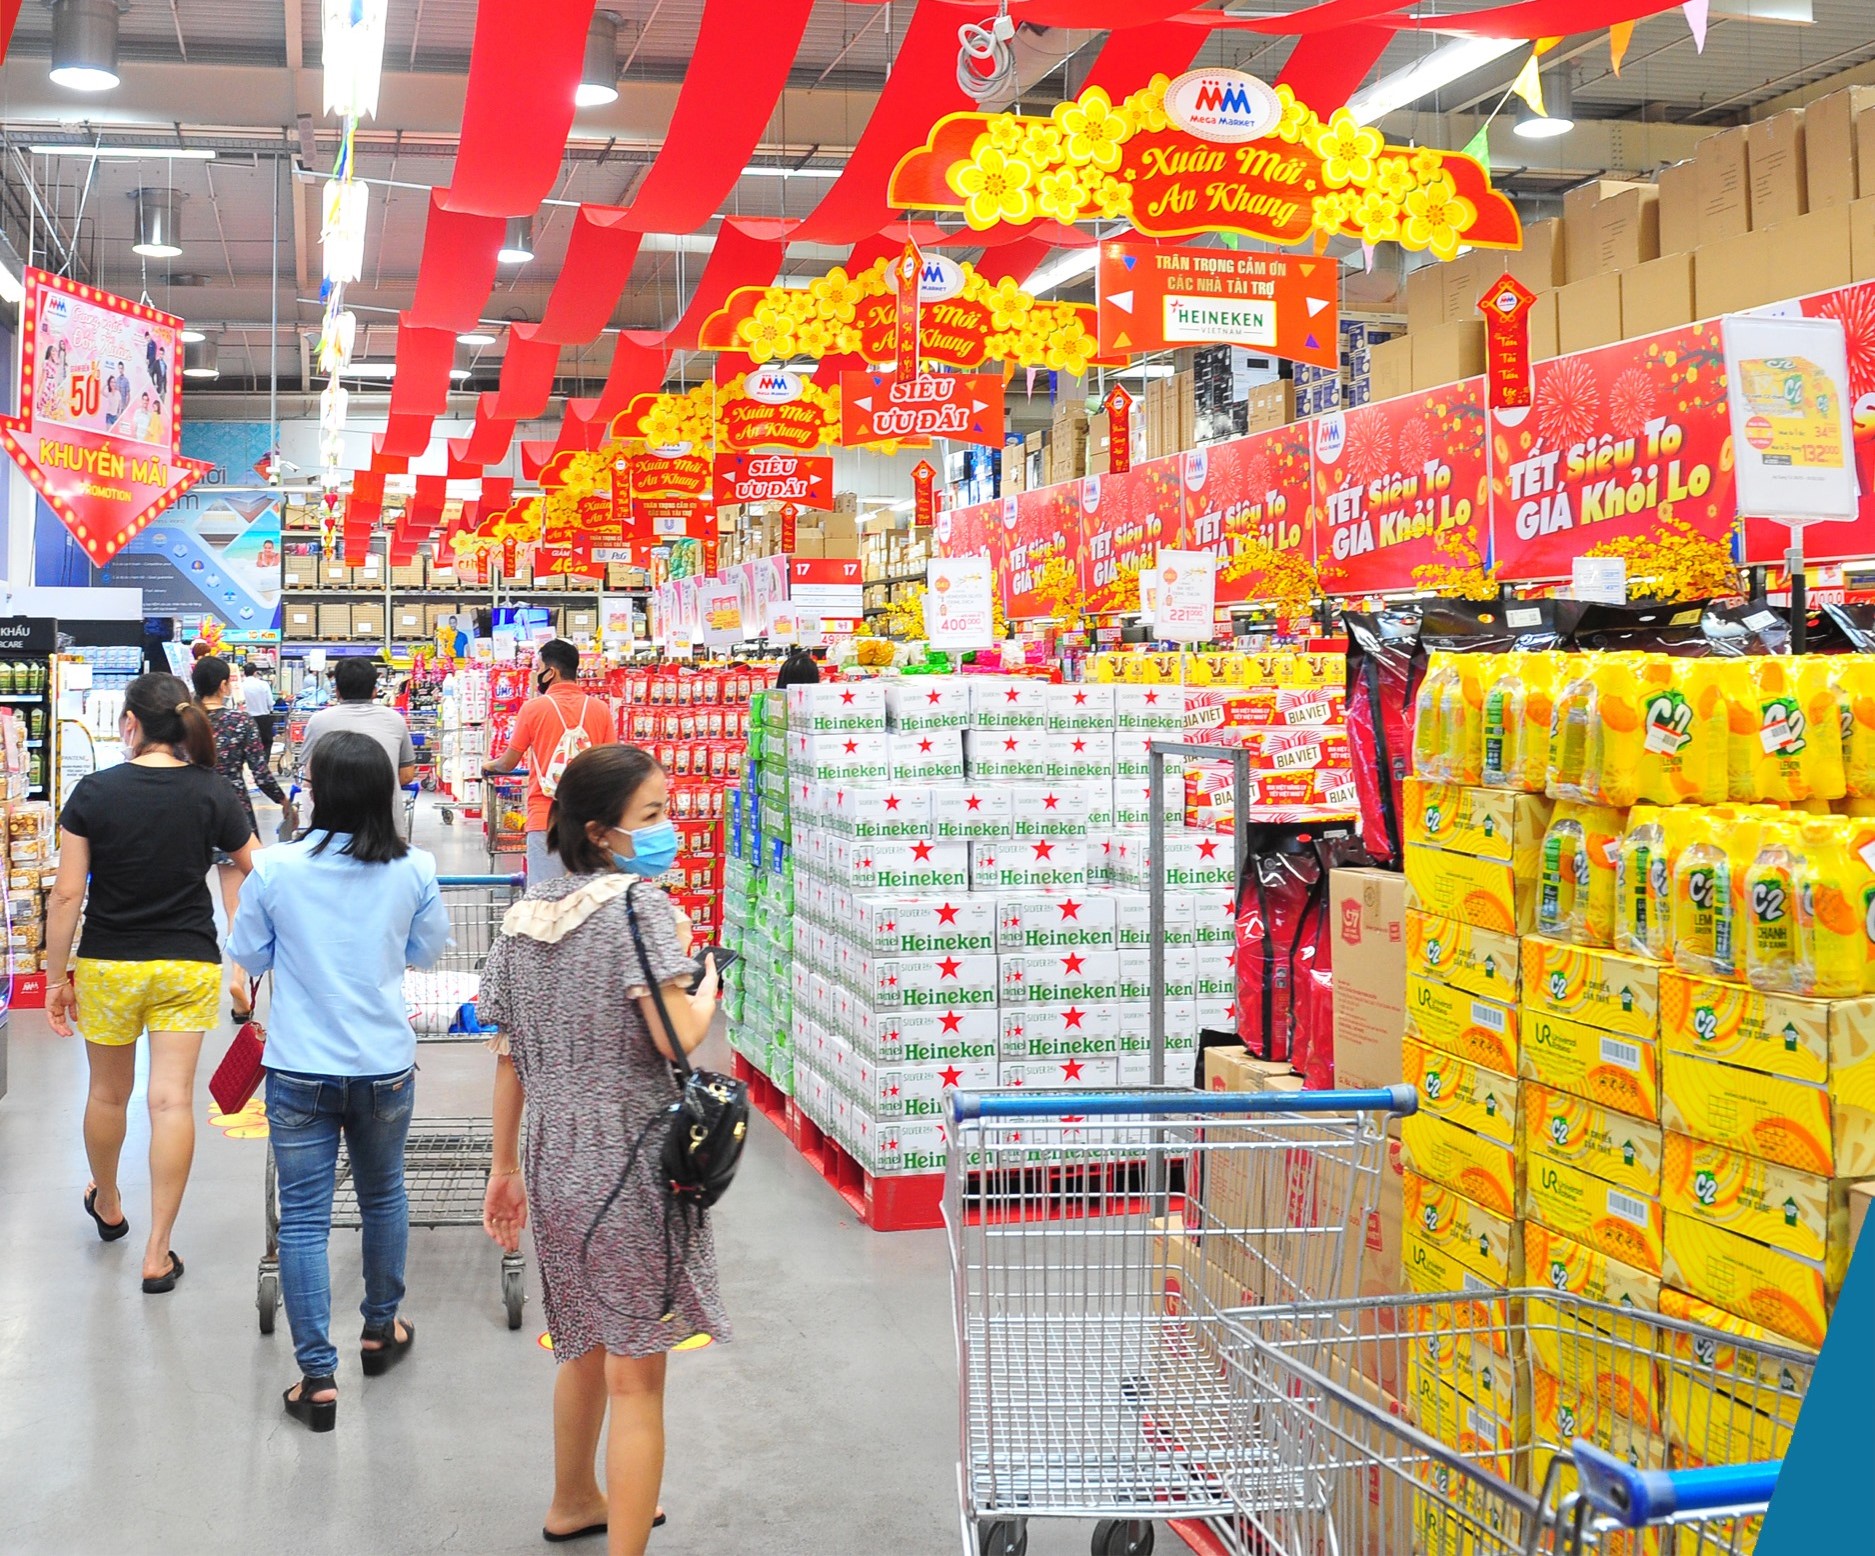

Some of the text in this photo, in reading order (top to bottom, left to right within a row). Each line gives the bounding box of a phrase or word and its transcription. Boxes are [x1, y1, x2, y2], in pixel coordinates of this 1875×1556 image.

[1142, 144, 1307, 185] Xuân Mới
[1148, 182, 1300, 226] An Khang
[1156, 254, 1287, 276] TRÂN TRỌNG CẢM ƠN
[1167, 274, 1275, 299] CÁC NHÀ TÀI TRỢ
[869, 304, 982, 329] Xun Mới
[1178, 310, 1264, 327] HEINEKEN
[872, 329, 897, 352] A
[1201, 327, 1242, 335] VIETNAM
[890, 374, 955, 402] SIÊU
[732, 405, 816, 423] Xuân Mới
[873, 404, 969, 434] ƯU ĐÃI
[735, 423, 812, 443] An Khang
[40, 438, 126, 480] KHUYẾN
[132, 455, 168, 488] MÃI
[748, 456, 798, 476] SIÊU
[1509, 437, 1560, 500] TẾT
[1567, 432, 1635, 483] Siêu
[1645, 416, 1683, 462] To
[81, 482, 132, 502] PROMOTION
[735, 477, 808, 498] ƯU ĐÃI
[1326, 458, 1451, 527] TẾT Siêu To
[1515, 459, 1711, 540] GIÁ Khỏi Lo
[1194, 489, 1286, 546] TẾT Siêu To
[1332, 494, 1471, 561] GIÁ Khỏi Lo
[1090, 513, 1162, 560] TẾT Siêu To
[1278, 520, 1301, 551] Lo
[1010, 537, 1027, 572] TẾT
[796, 563, 857, 576] 17 17
[1094, 550, 1118, 587] GIÁ
[814, 716, 884, 730] Heineken
[901, 714, 968, 731] Heineken
[978, 713, 1044, 726] Heineken
[1049, 716, 1114, 729] Heineken
[1118, 714, 1183, 728] Heineken
[1200, 708, 1222, 723] VIỆT
[1288, 704, 1327, 724] BIA VIỆT
[1277, 747, 1318, 768] BIA VIỆT
[817, 764, 887, 780] Heineken
[893, 763, 962, 779] Heineken
[976, 762, 1043, 775] Heineken
[1046, 764, 1111, 777] Heineken
[1214, 790, 1233, 806] BIA
[1330, 791, 1347, 804] BIA
[855, 821, 929, 837] Heineken
[938, 822, 1010, 836] Heineken
[1016, 820, 1086, 835] Heineken
[1426, 809, 1440, 831] C2
[878, 868, 965, 887] Heineken
[1000, 869, 1084, 886] Heineken
[1166, 868, 1235, 884] Heineke
[1752, 884, 1786, 921] C2
[1694, 914, 1713, 926] LEM
[901, 933, 992, 951] Heineken
[1025, 928, 1113, 946] Heineken
[1427, 940, 1441, 964] C2
[902, 987, 994, 1006] Heineken
[1028, 983, 1116, 1001] Heineken
[1199, 981, 1234, 994] Hein
[1551, 974, 1567, 999] C2
[1695, 1010, 1717, 1039] C2
[904, 1041, 996, 1060] Heineken
[1028, 1037, 1116, 1055] Heineken
[1426, 1073, 1441, 1098] C2
[1552, 1119, 1568, 1145] C2
[1695, 1173, 1718, 1204] C2
[1424, 1208, 1438, 1231] C2
[1551, 1263, 1568, 1290] C2
